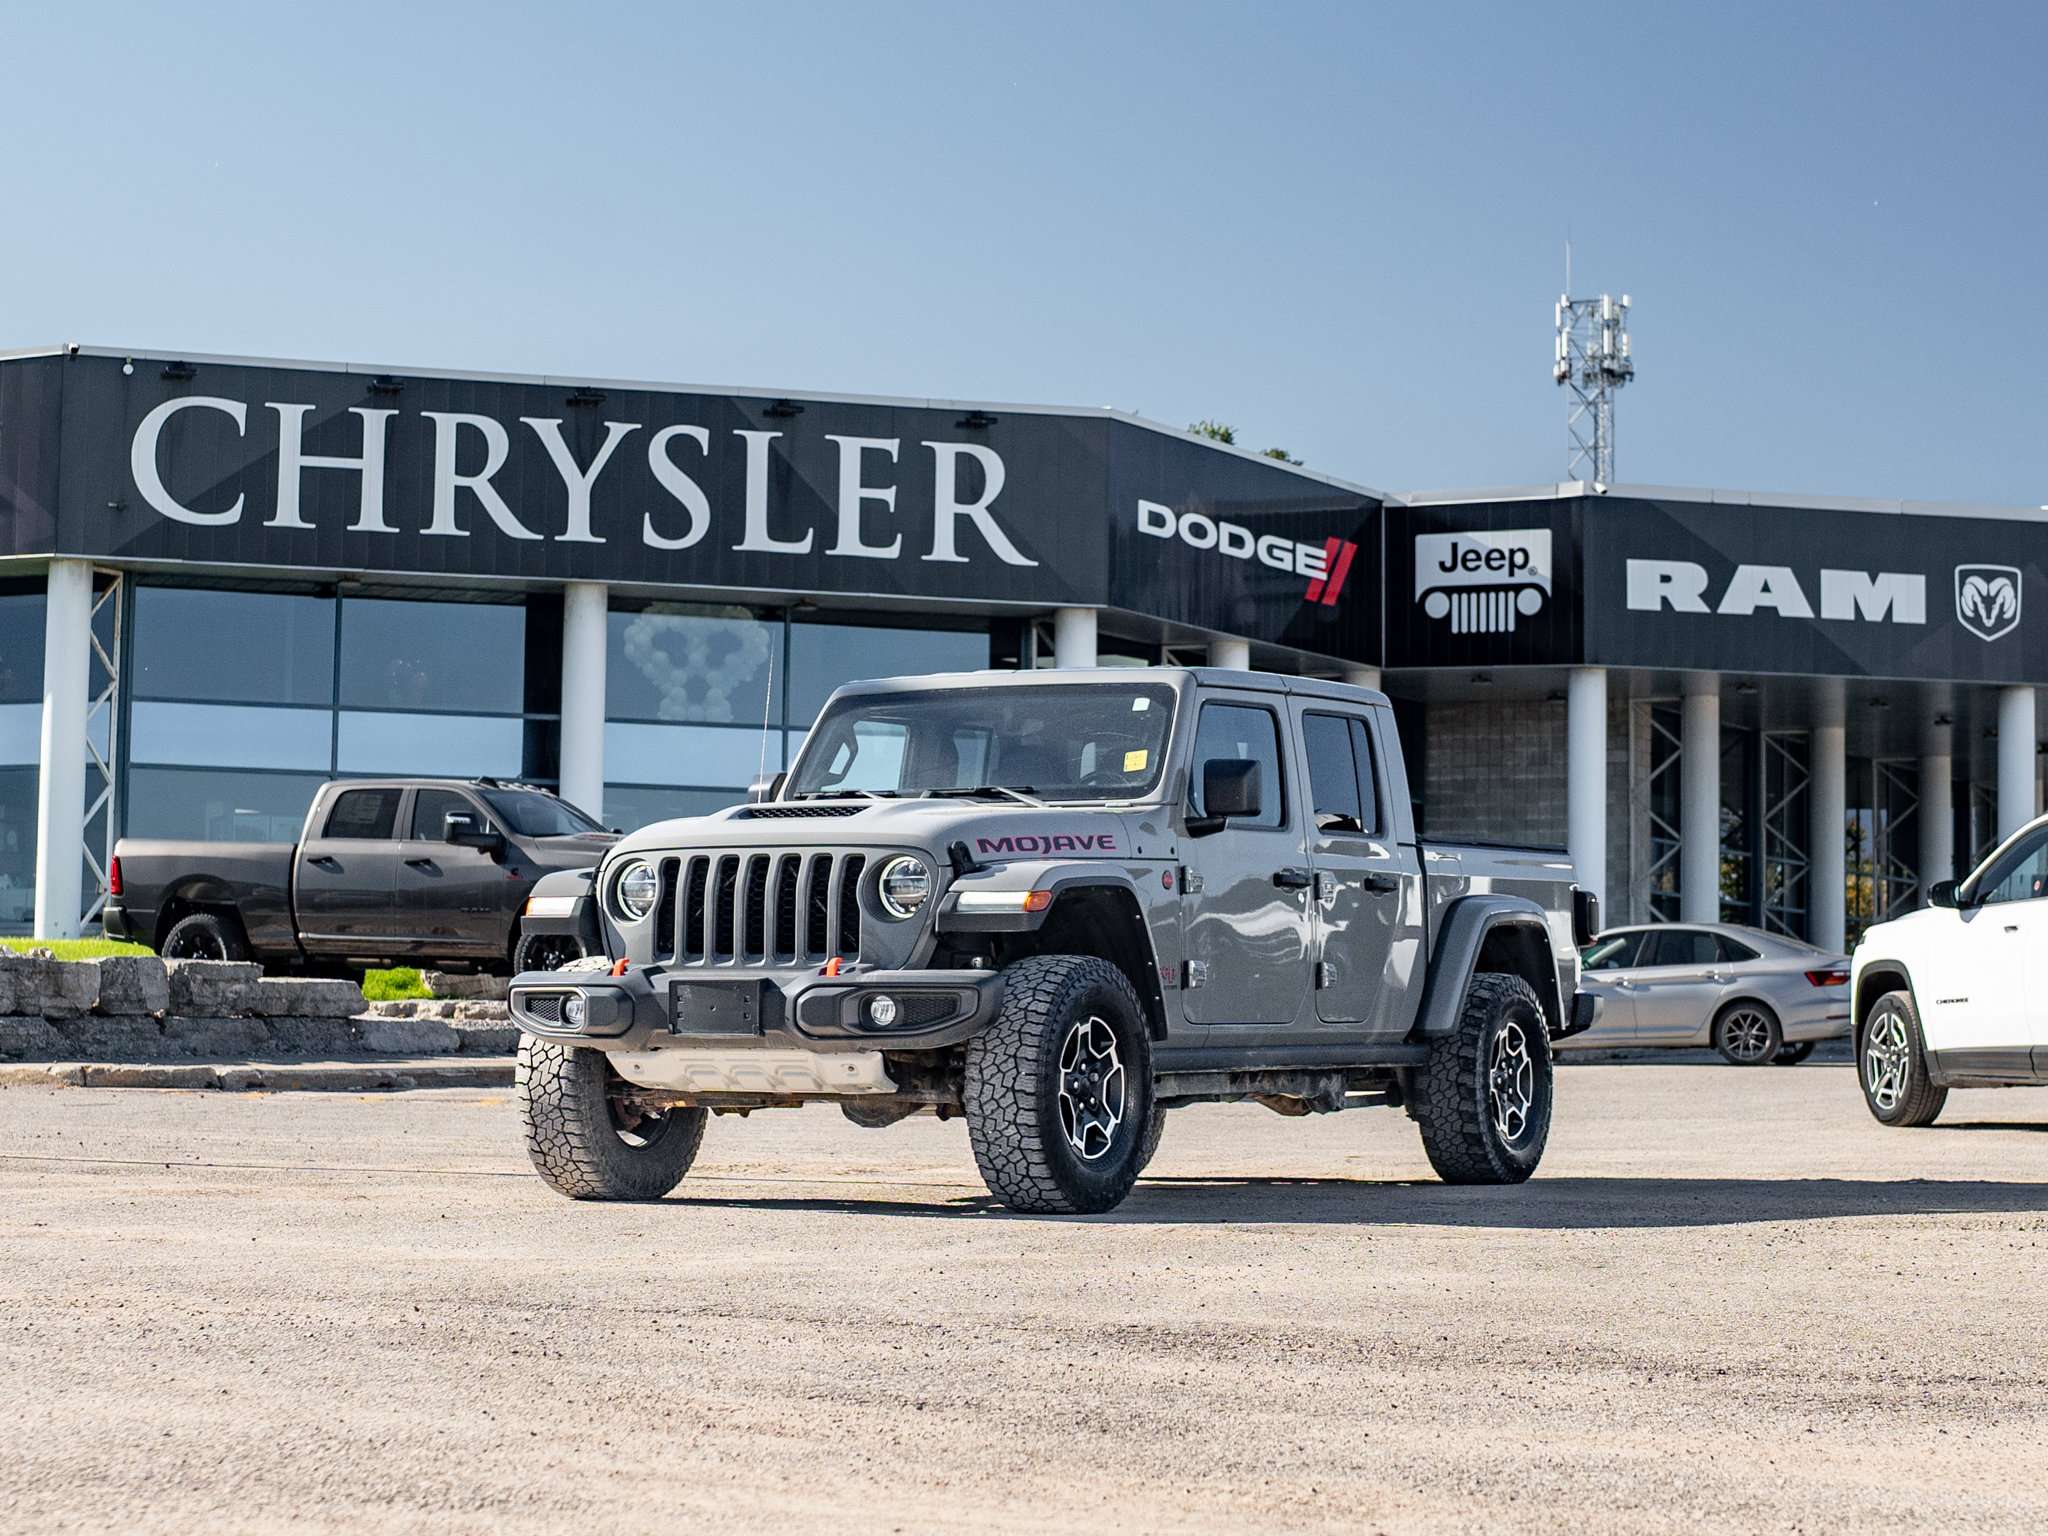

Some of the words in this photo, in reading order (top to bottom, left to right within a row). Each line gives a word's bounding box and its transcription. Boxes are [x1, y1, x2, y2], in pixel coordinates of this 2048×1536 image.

[131, 396, 1038, 567] CHRYSLER
[1137, 499, 1328, 581] DODGE
[1439, 542, 1530, 578] Jeep
[1626, 558, 1927, 625] RAM
[976, 834, 1117, 855] MOJAVE
